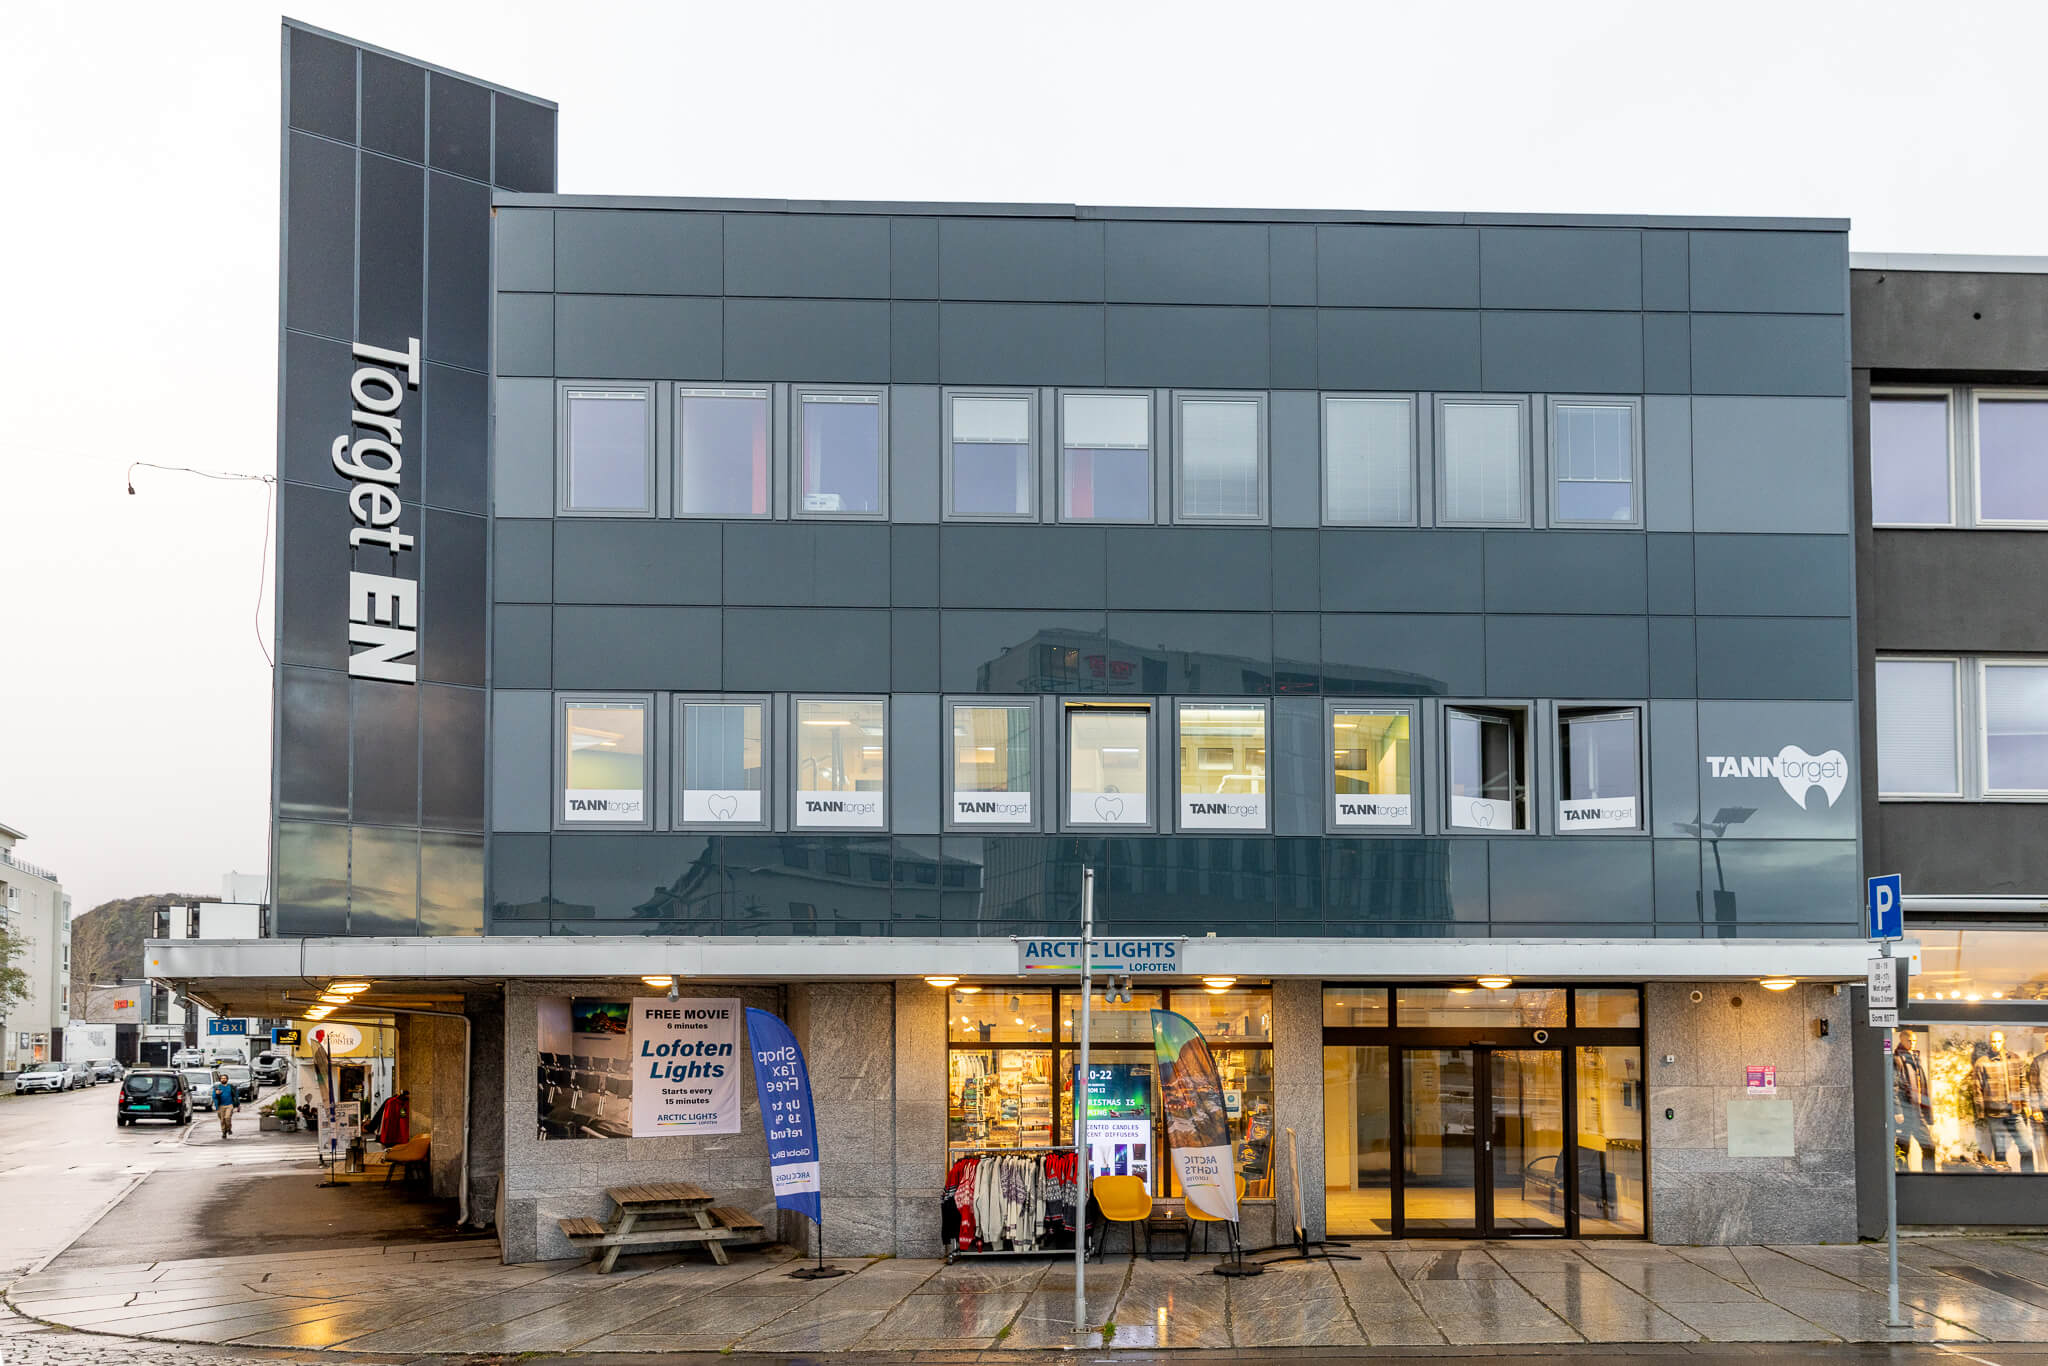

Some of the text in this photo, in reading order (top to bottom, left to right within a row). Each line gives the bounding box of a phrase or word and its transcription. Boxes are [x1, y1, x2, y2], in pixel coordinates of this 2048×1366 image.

[332, 337, 419, 683] Torget EN
[1706, 756, 1842, 783] TANNtorget
[569, 800, 640, 814] TANNtorget
[806, 801, 876, 815] TANNtorget
[958, 802, 1028, 816] TANNtorget
[1189, 803, 1258, 817] TANNtorget
[1339, 804, 1409, 818] TANNtorget
[1563, 807, 1633, 821] TANNtorget
[1876, 885, 1893, 930] P
[1104, 942, 1175, 958] LIGHTS
[1129, 963, 1176, 972] LOFOTEN
[645, 1010, 728, 1019] FREE MOVIE
[213, 1022, 243, 1032] Taxi
[641, 1040, 732, 1057] Lofoten
[650, 1060, 724, 1082] Lights
